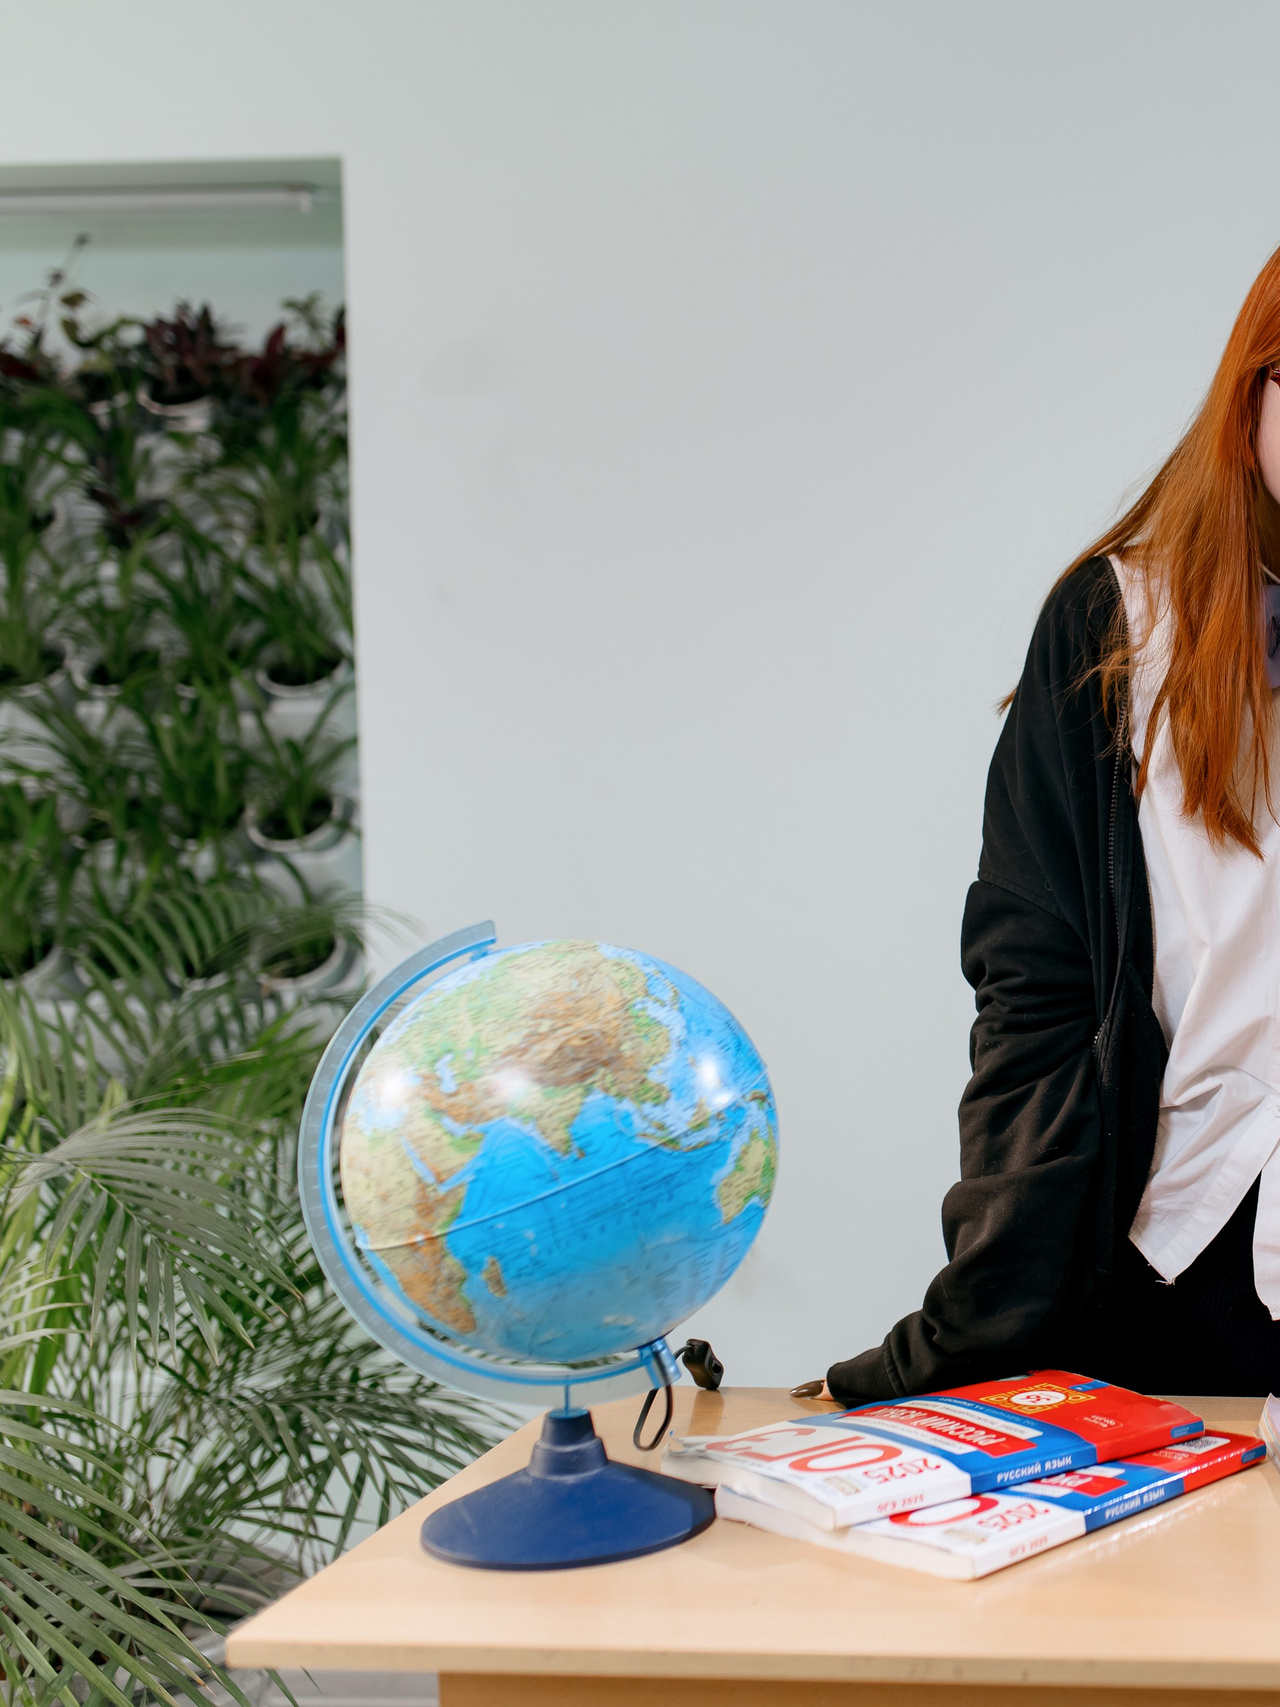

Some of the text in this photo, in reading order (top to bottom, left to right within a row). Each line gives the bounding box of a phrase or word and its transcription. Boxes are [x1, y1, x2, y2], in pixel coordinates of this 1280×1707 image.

[705, 1428, 902, 1472] ОГЭ
[863, 1458, 941, 1484] 2025
[997, 1456, 1072, 1483] РУССКИЙ ЯЗЫК
[901, 1494, 924, 1508] 2025
[1105, 1487, 1165, 1519] РУССКИЙ ЯЗЫК
[977, 1503, 1049, 1531] 2025
